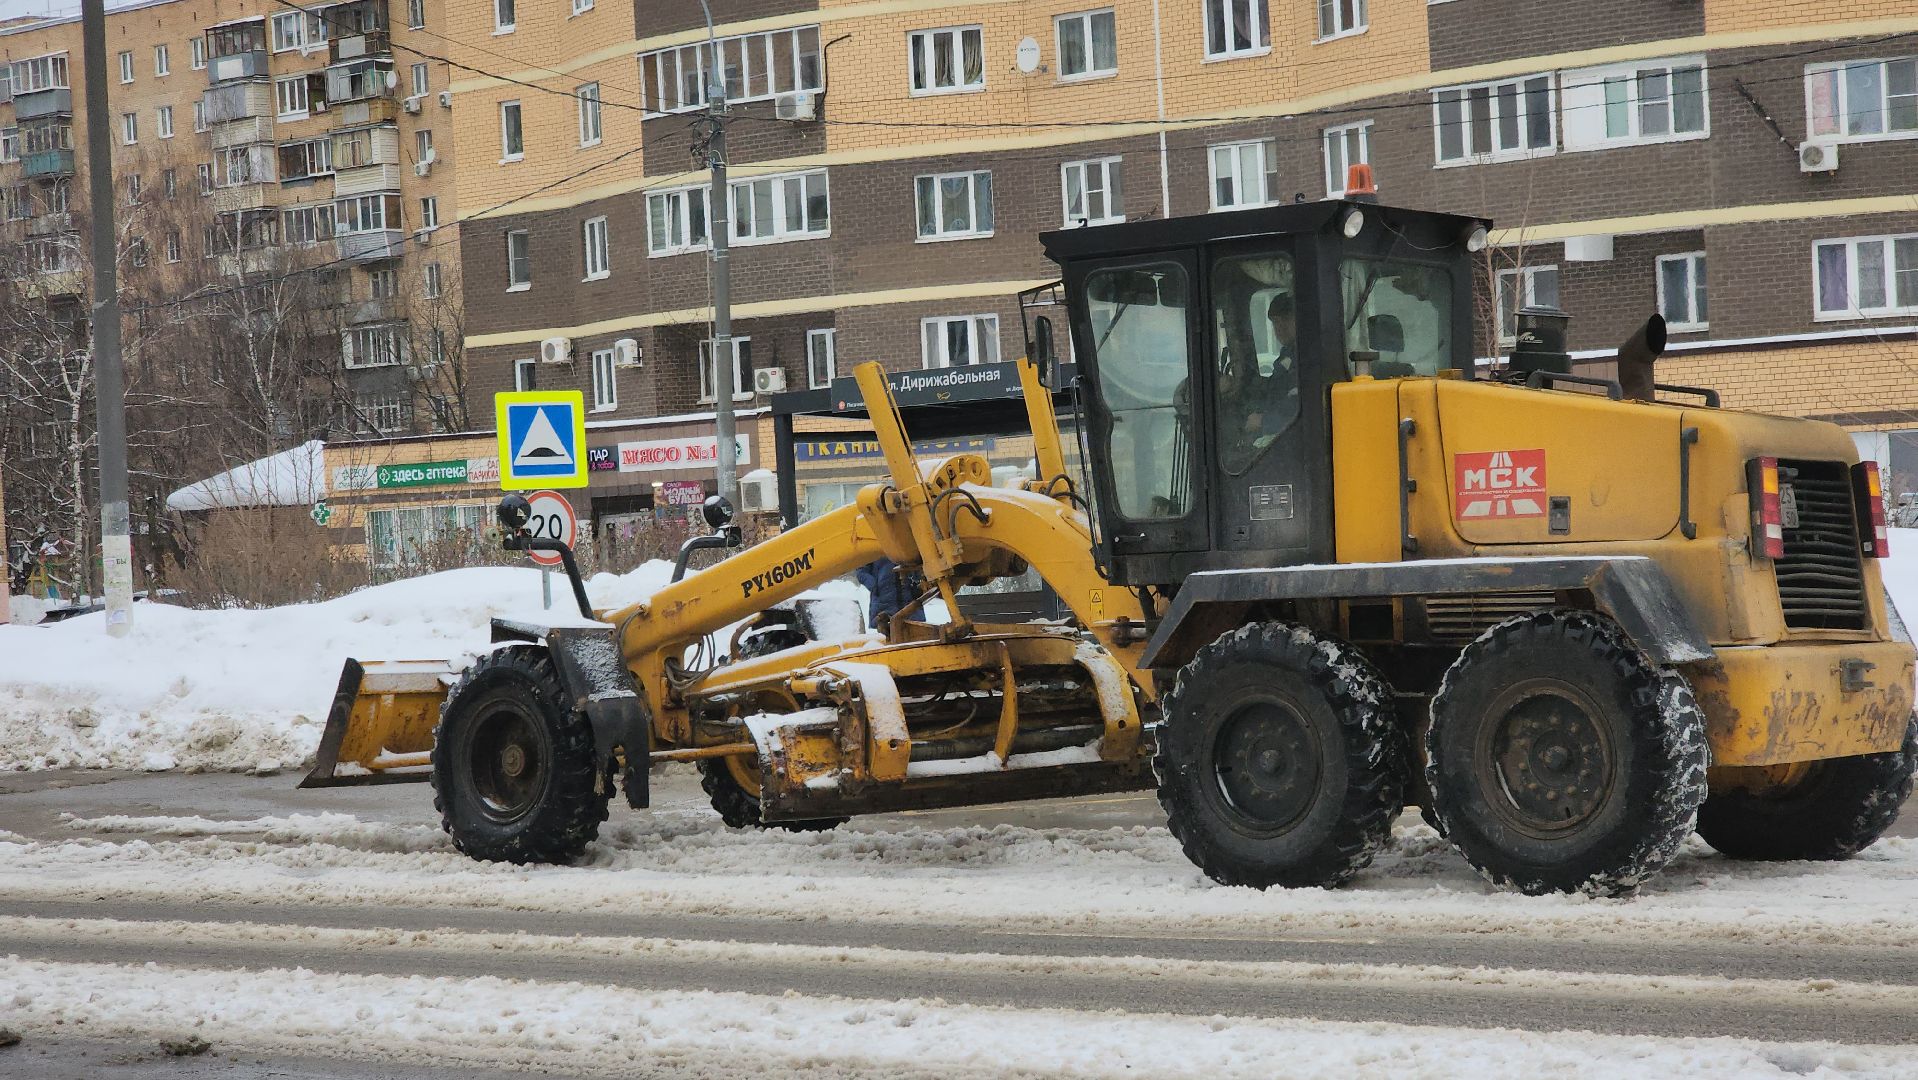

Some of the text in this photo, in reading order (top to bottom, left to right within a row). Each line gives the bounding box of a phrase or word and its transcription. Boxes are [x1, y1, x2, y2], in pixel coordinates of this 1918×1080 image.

[901, 370, 1000, 391] Дирижабельная
[589, 449, 609, 462] ПАР
[622, 446, 682, 465] МЯСО
[392, 466, 466, 482] здесь аптека
[532, 513, 562, 540] 20
